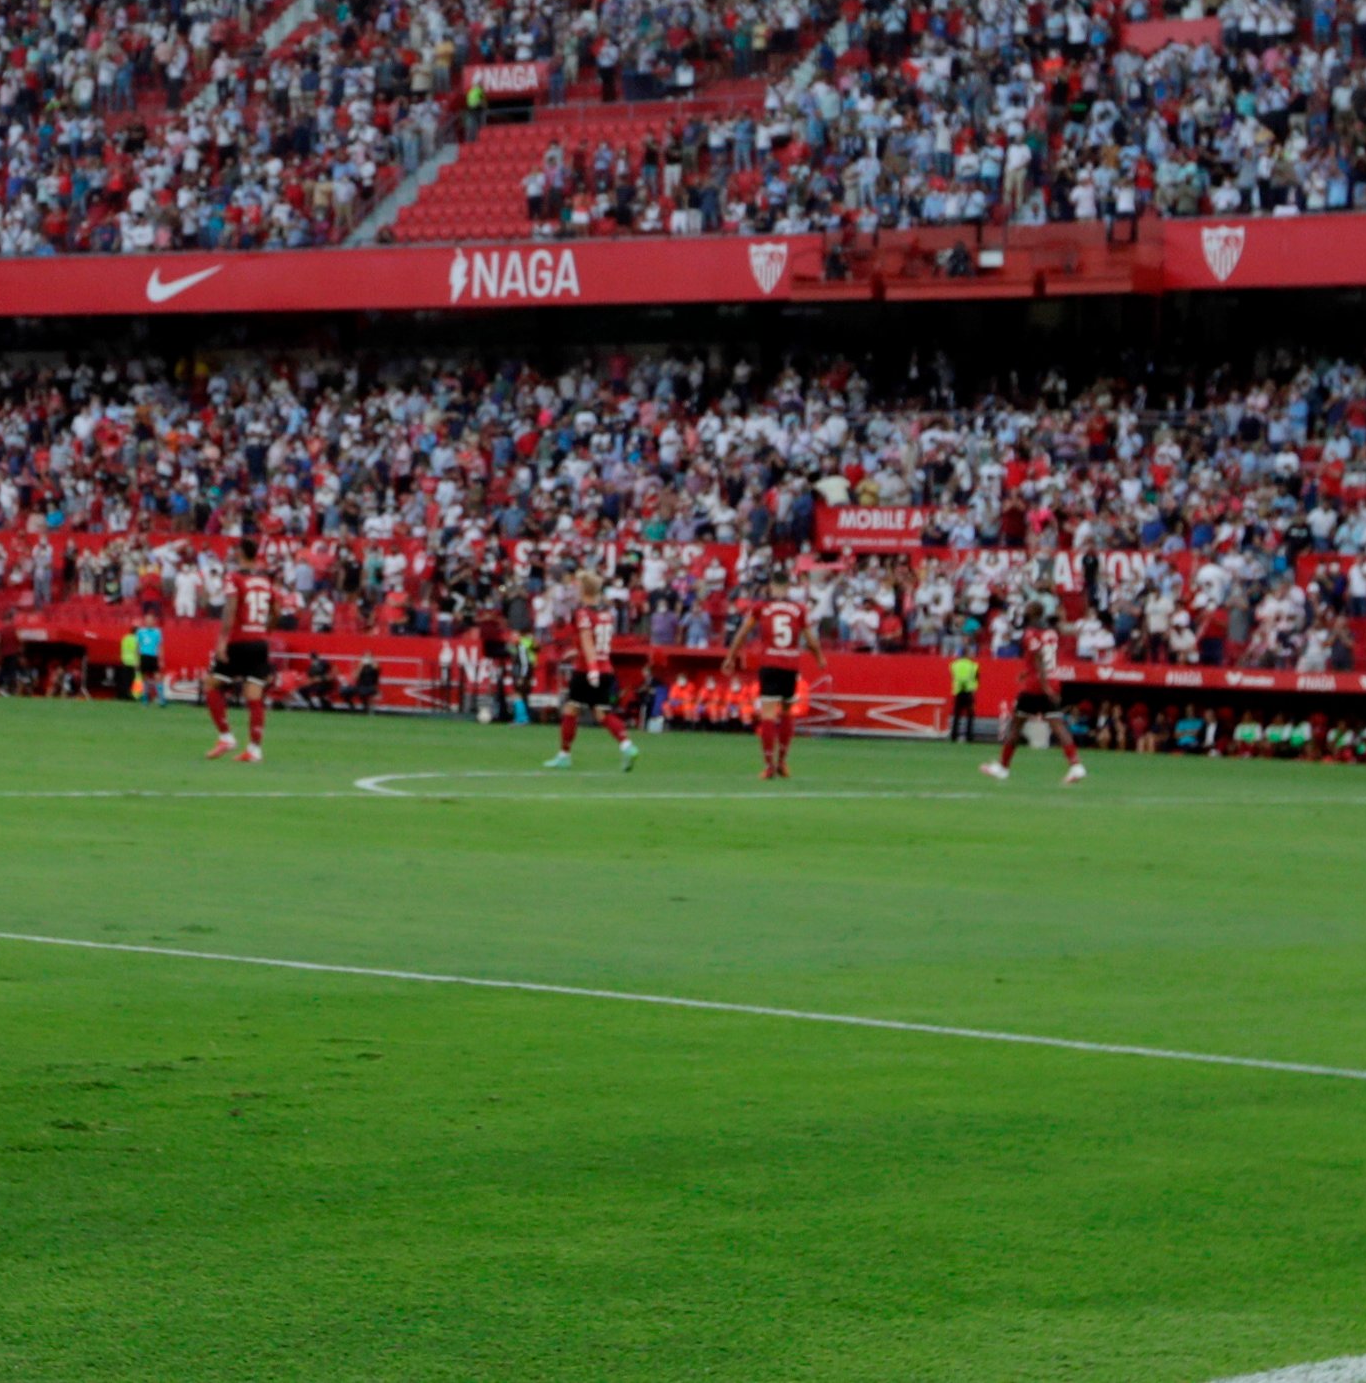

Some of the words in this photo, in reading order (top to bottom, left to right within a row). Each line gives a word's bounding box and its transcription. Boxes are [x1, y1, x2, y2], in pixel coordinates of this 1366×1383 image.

[483, 64, 539, 92] NAGA
[471, 248, 580, 298] NAGA
[837, 509, 907, 530] MOBILE
[772, 615, 793, 649] 5
